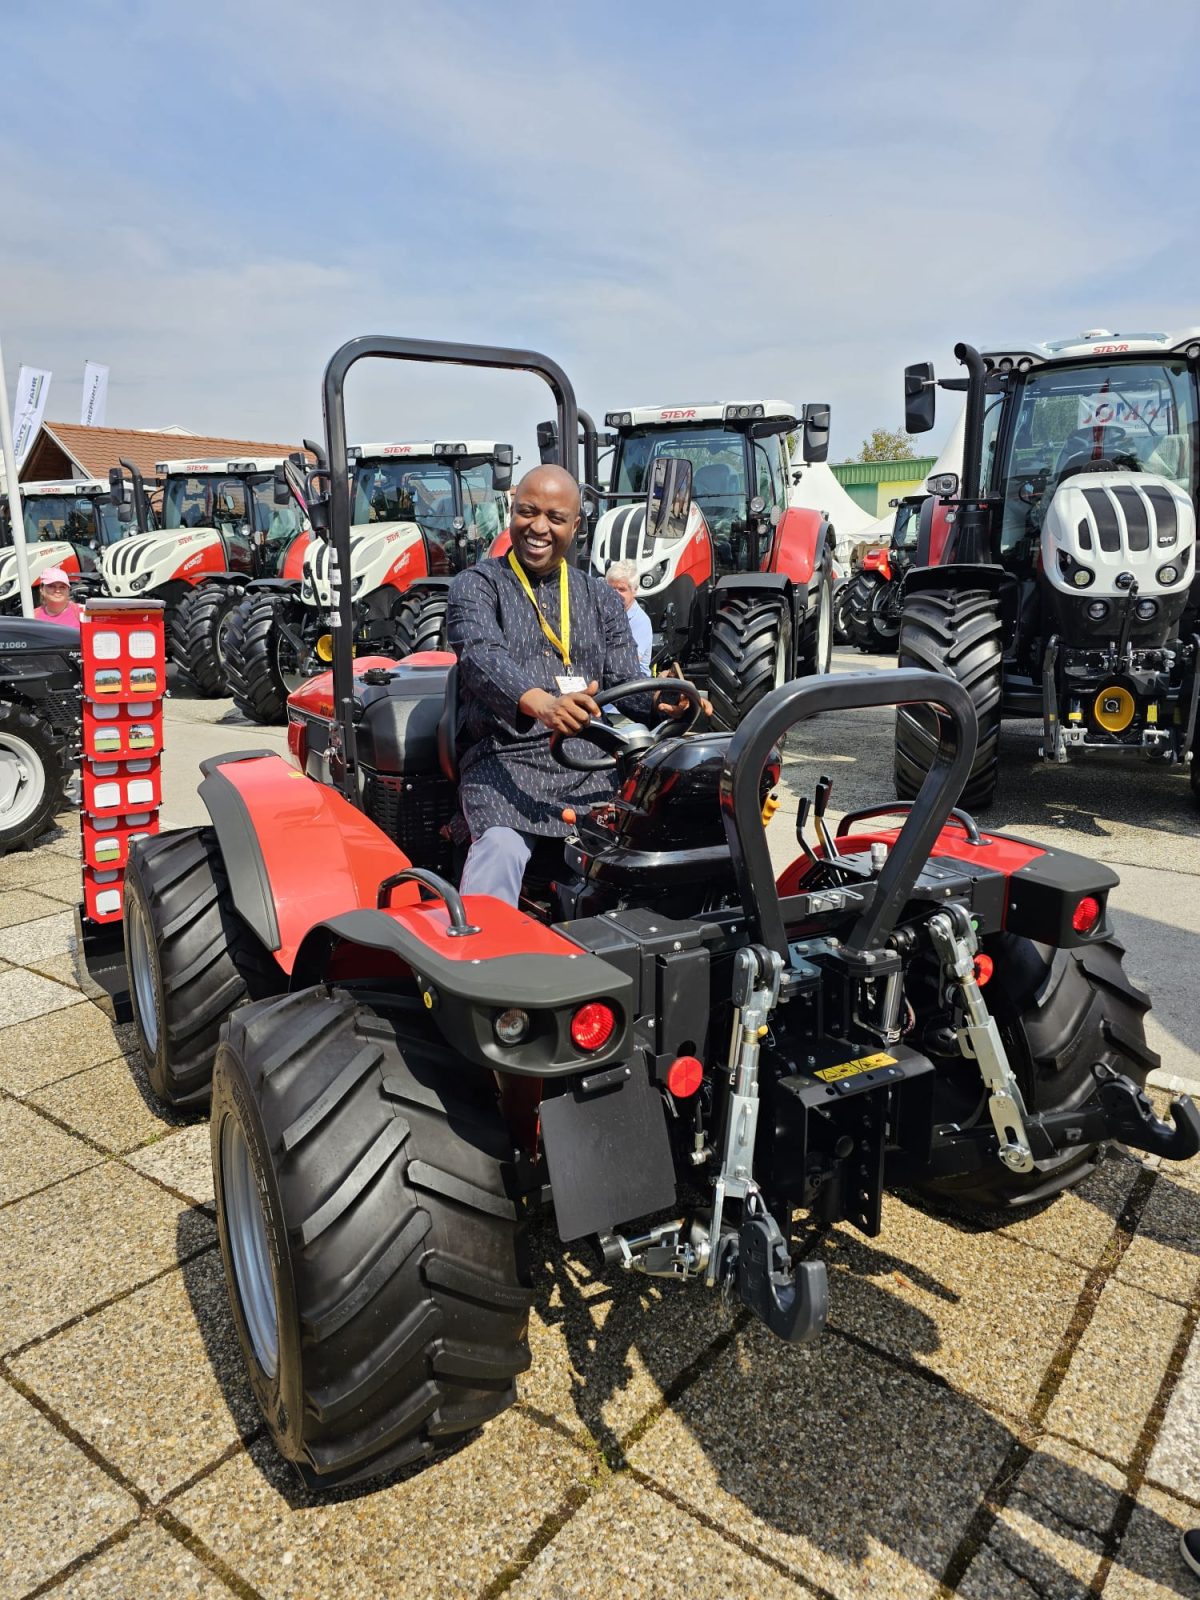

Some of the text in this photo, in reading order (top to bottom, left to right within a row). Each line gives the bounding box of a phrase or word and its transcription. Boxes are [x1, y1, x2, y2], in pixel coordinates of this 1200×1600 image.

[1092, 344, 1129, 354] STEYR
[660, 409, 696, 420] STEYR
[384, 446, 412, 454] STEYR
[178, 536, 193, 545] STEYR
[6, 641, 27, 649] 1060
